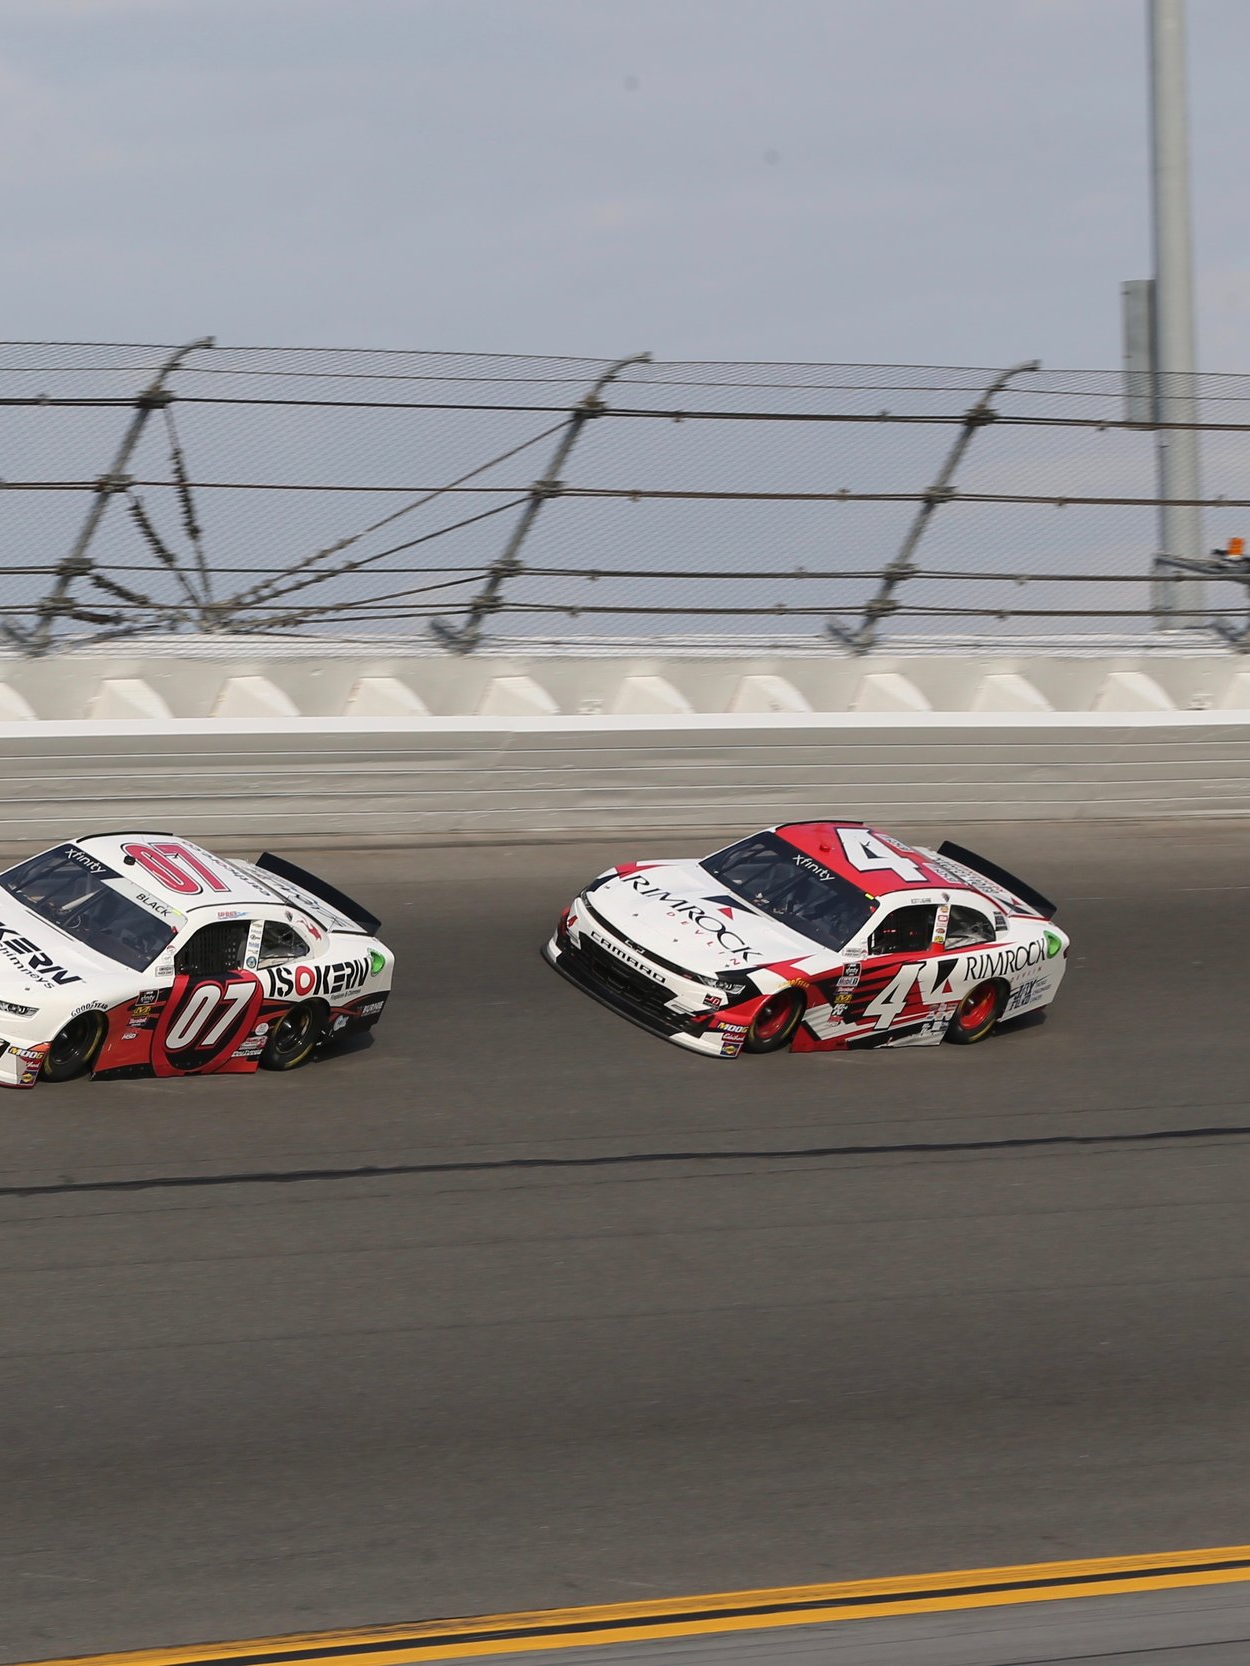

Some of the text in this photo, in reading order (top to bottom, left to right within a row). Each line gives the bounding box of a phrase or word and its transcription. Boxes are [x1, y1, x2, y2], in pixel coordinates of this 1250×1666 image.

[65, 848, 107, 874] xfinity
[121, 842, 231, 895] 07
[792, 854, 836, 881] xfinity
[835, 828, 929, 882] 4
[135, 892, 173, 918] BLACK
[621, 874, 764, 963] RIMROCK
[590, 930, 667, 984] CAMARO
[666, 910, 741, 967] DEVLIN
[963, 937, 1046, 982] RIMROCK
[267, 957, 370, 998] ISOKERN
[862, 963, 926, 1031] 4
[71, 1000, 109, 1018] GOODYEAR
[165, 981, 258, 1050] 07
[717, 1022, 750, 1034] MOOG
[9, 1046, 46, 1060] MOOG
